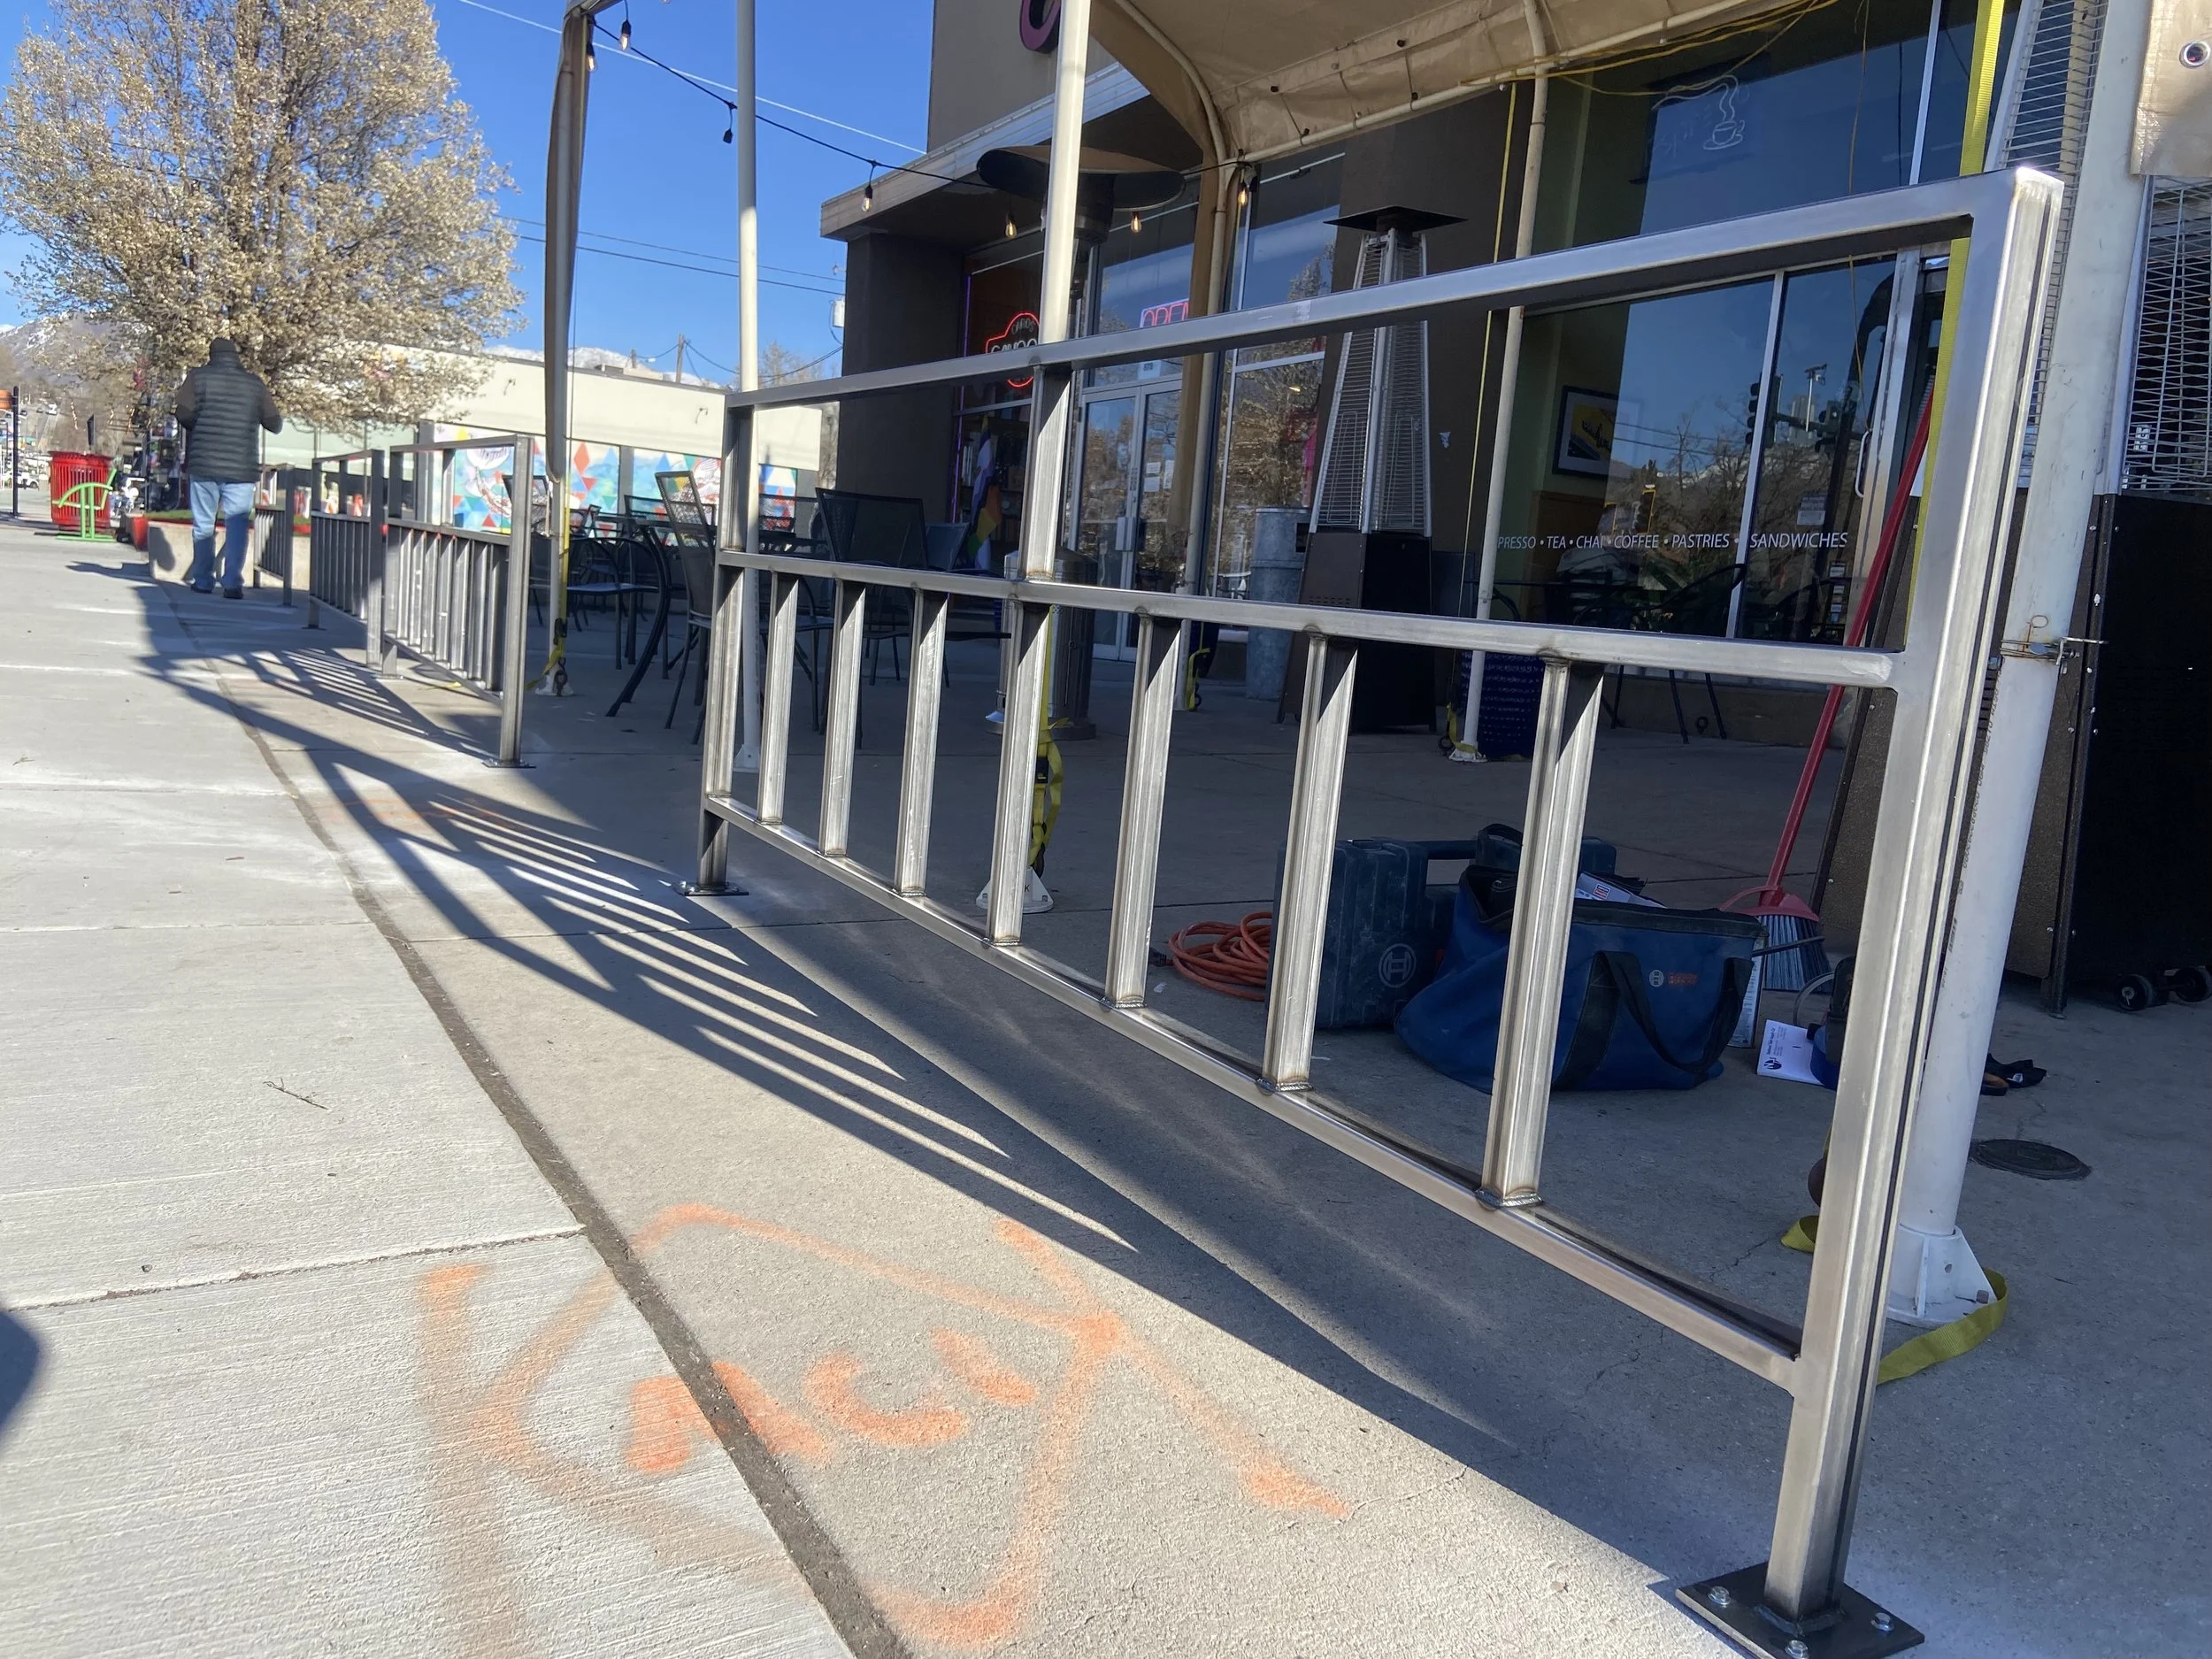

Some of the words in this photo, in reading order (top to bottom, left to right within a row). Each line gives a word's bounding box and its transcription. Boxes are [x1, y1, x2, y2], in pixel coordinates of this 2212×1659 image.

[1143, 302, 1188, 326] OPE
[1497, 535, 1537, 549] PRESSO
[1547, 535, 1567, 549] TEA
[1576, 534, 1604, 549] CHAI
[1614, 534, 1660, 549] COFFEE
[1671, 534, 1730, 549] PASTRIES
[1749, 532, 1848, 549] SANDWICHES
